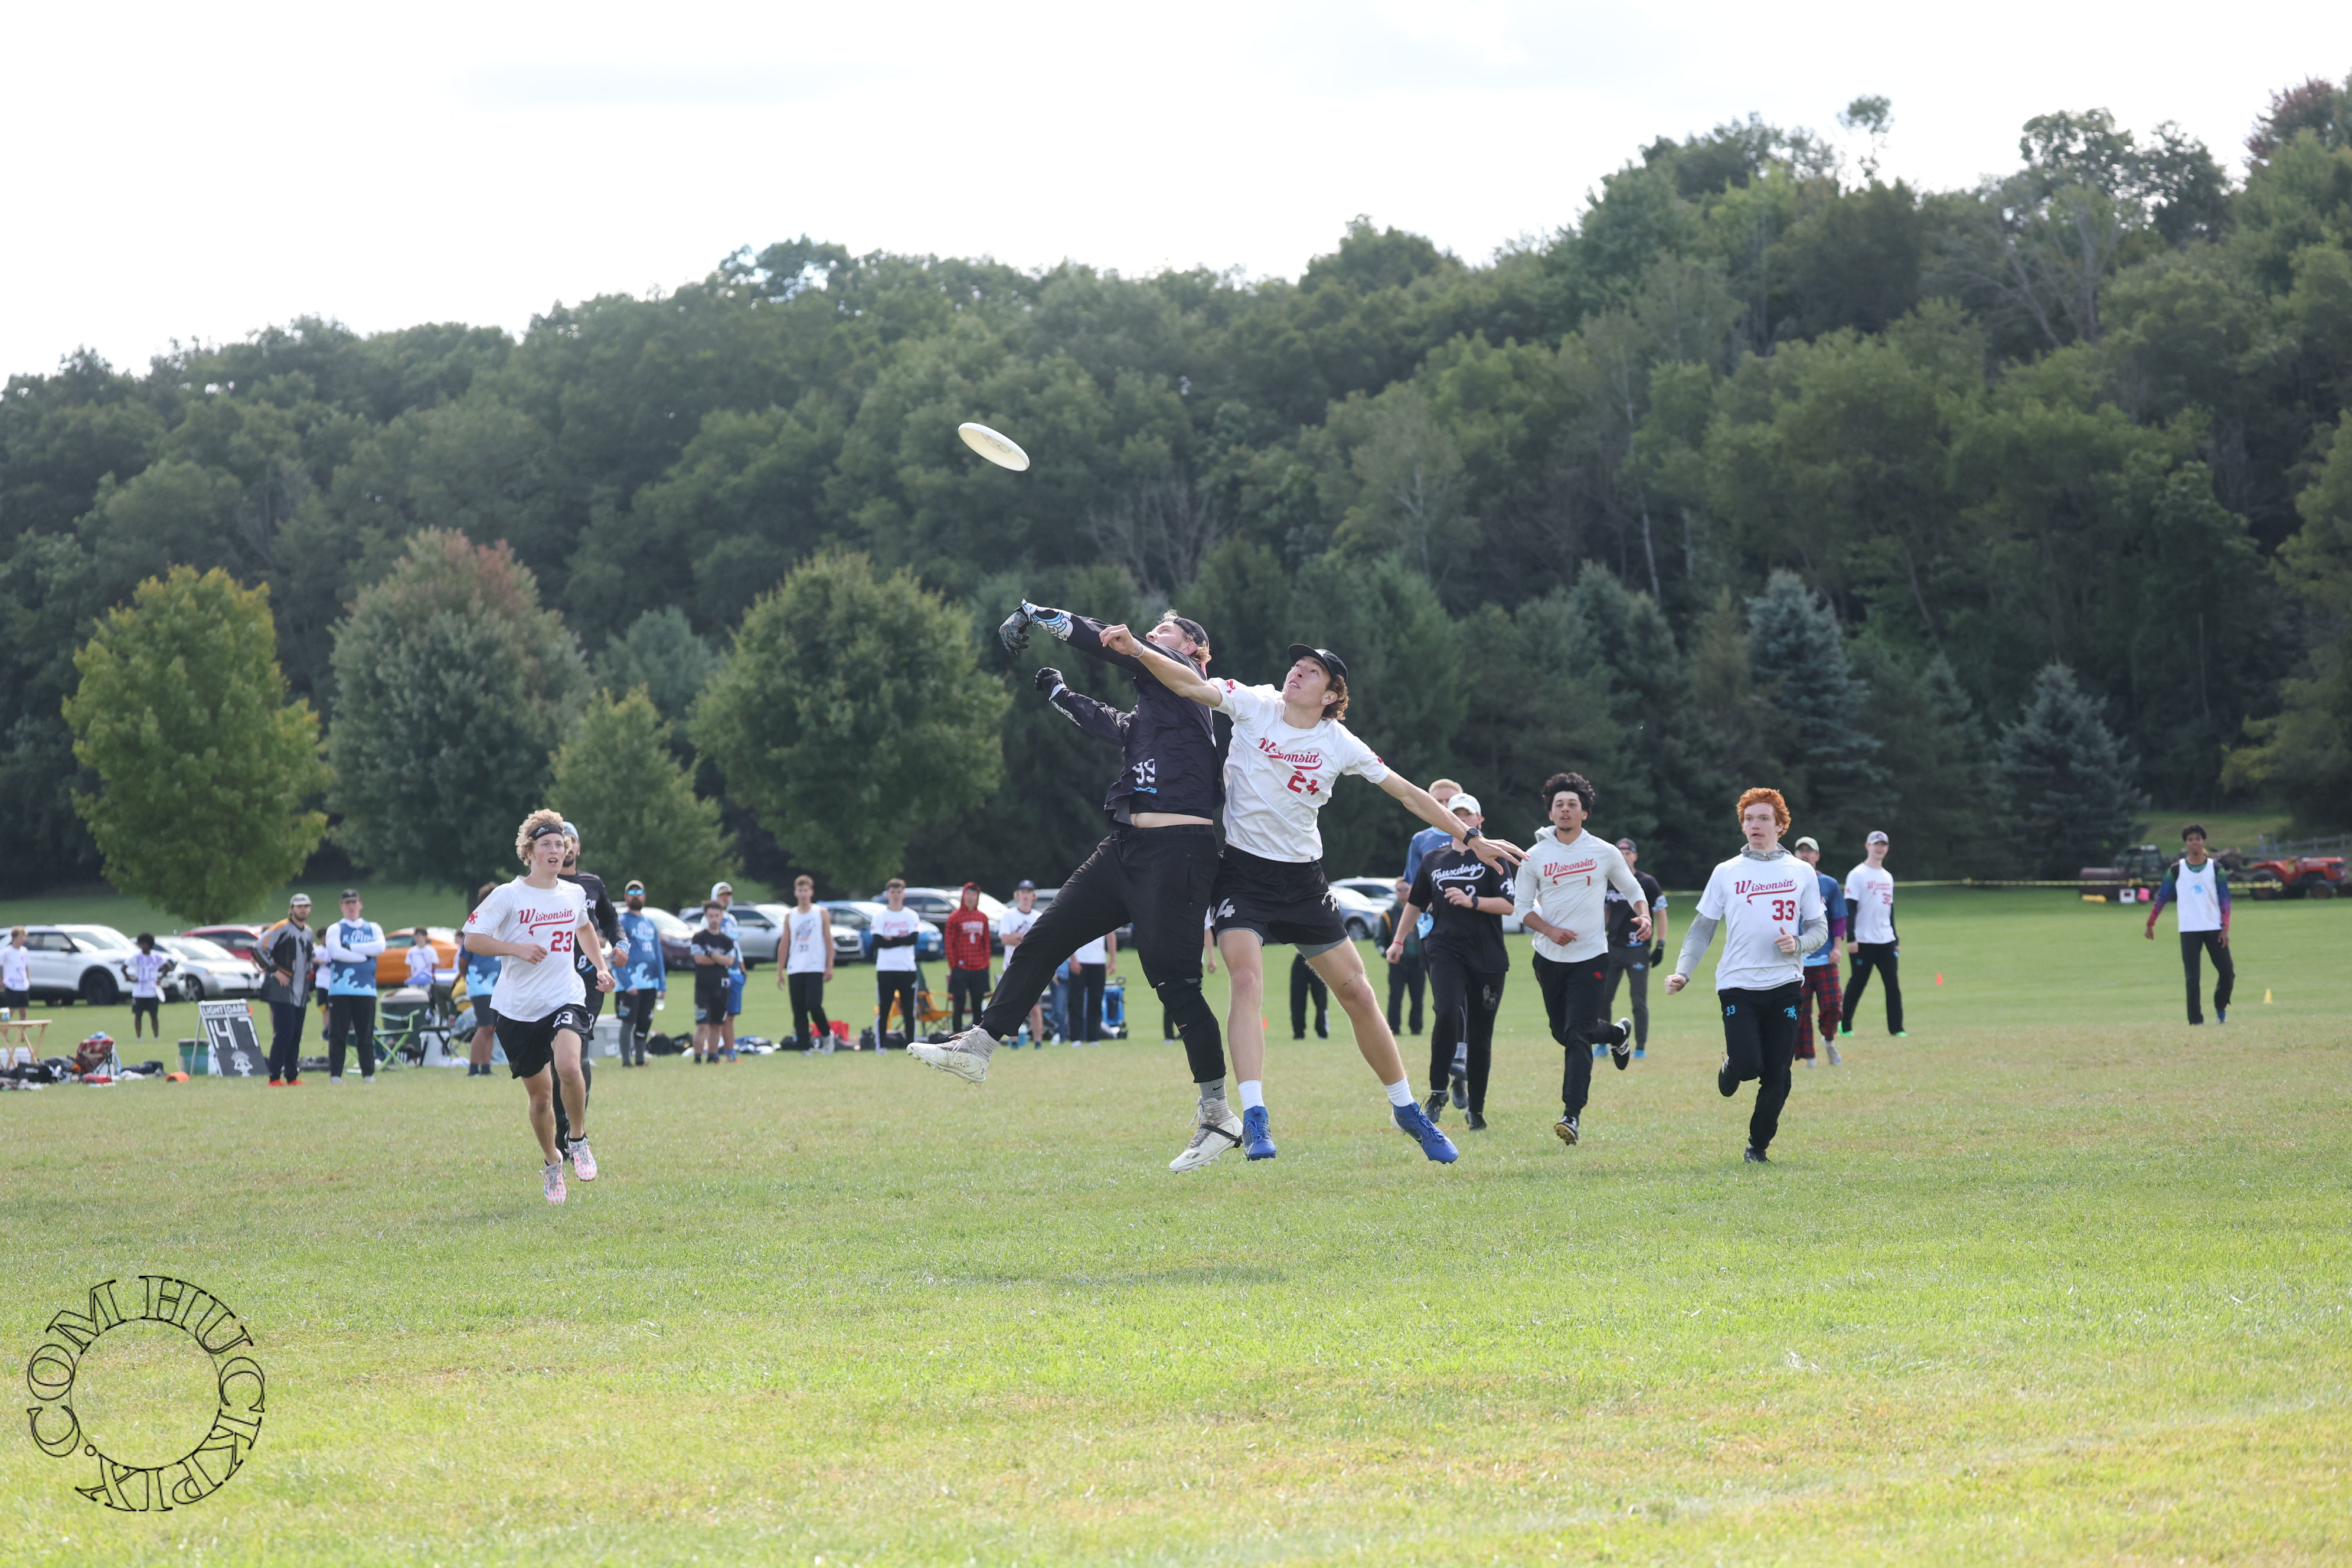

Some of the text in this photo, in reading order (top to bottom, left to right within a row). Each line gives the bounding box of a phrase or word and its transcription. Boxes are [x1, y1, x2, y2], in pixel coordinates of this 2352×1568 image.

[1287, 770, 1319, 795] 24
[1431, 863, 1482, 881] Fauxdags
[1543, 858, 1594, 877] Wisconsin
[1586, 876, 1591, 886] 1
[1734, 879, 1794, 894] Wisconsin
[518, 909, 573, 924] Wisconsin
[1772, 900, 1795, 920] 33
[551, 931, 573, 952] 23
[202, 1004, 247, 1015] LIGHT DARK
[1726, 1005, 1736, 1016] 33
[553, 1011, 573, 1028] 23
[208, 1017, 259, 1049] 14 7
